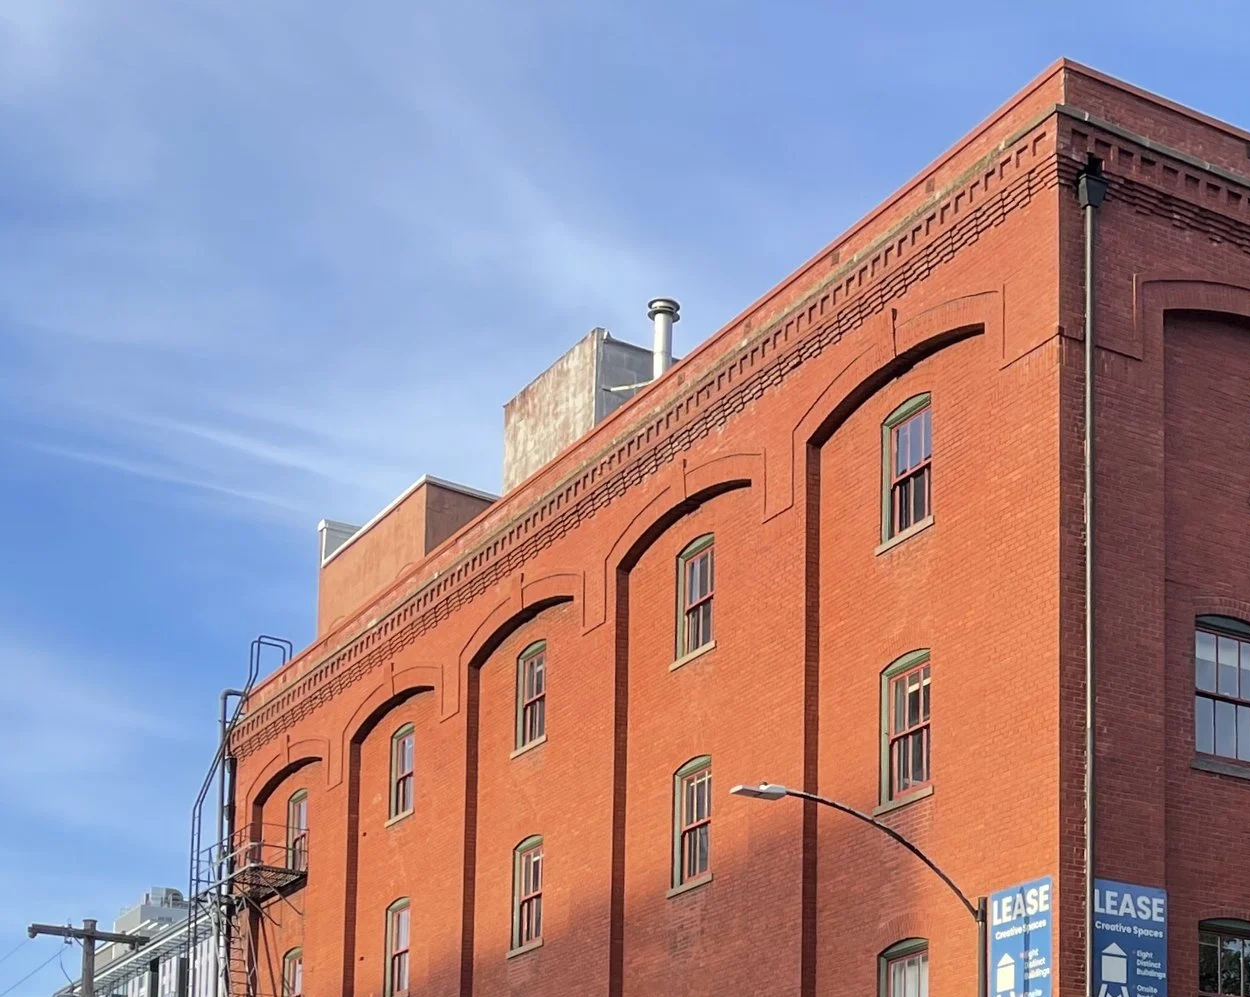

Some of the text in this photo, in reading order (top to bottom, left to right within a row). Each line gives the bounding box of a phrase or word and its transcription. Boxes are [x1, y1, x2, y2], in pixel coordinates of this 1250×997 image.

[993, 884, 1050, 926] LEASE
[1094, 888, 1165, 922] LEASE
[995, 919, 1047, 940] Creative Spaces
[1095, 920, 1164, 938] Creative Spaces
[1136, 949, 1153, 960] Eight
[1136, 958, 1161, 969] Distinct
[1136, 967, 1167, 980] Buildings
[1136, 984, 1158, 994] Onsite
